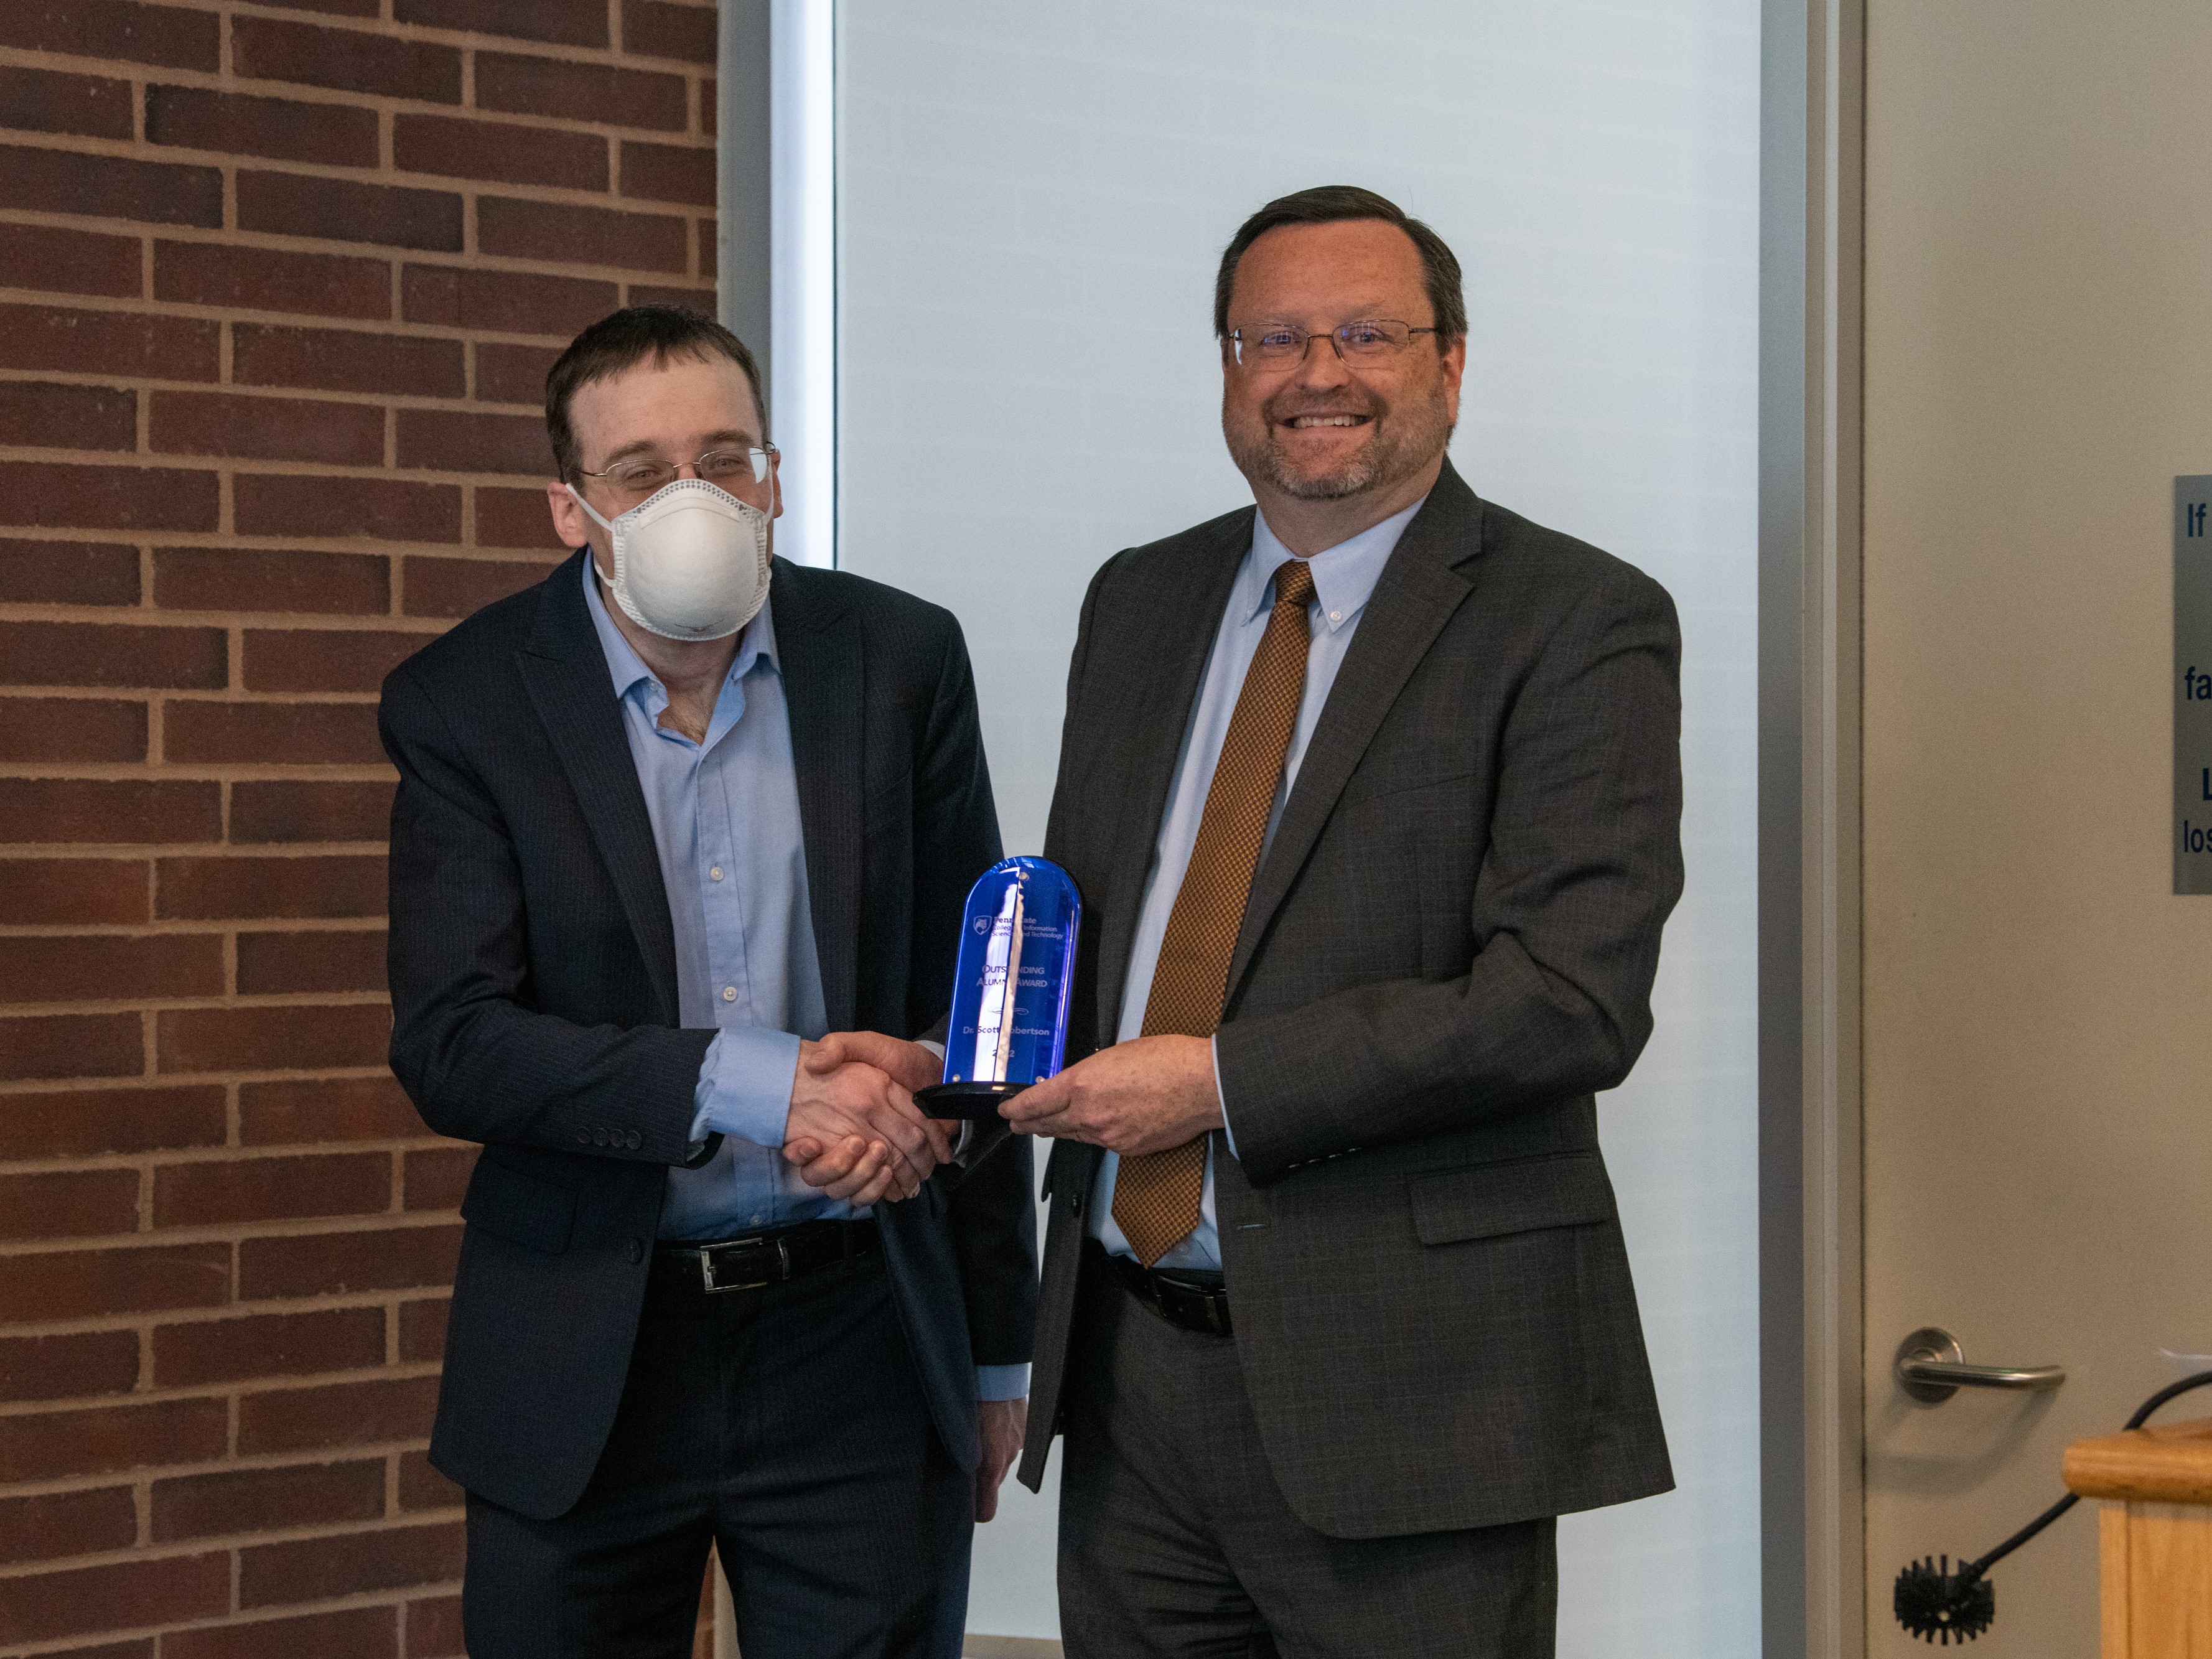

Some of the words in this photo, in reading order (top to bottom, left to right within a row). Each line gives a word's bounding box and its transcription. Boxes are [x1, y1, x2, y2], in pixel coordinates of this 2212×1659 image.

[2188, 503, 2206, 537] If
[1030, 932, 1064, 940] Technology
[1007, 1026, 1050, 1035] obertson
[992, 1049, 1015, 1058] 22
